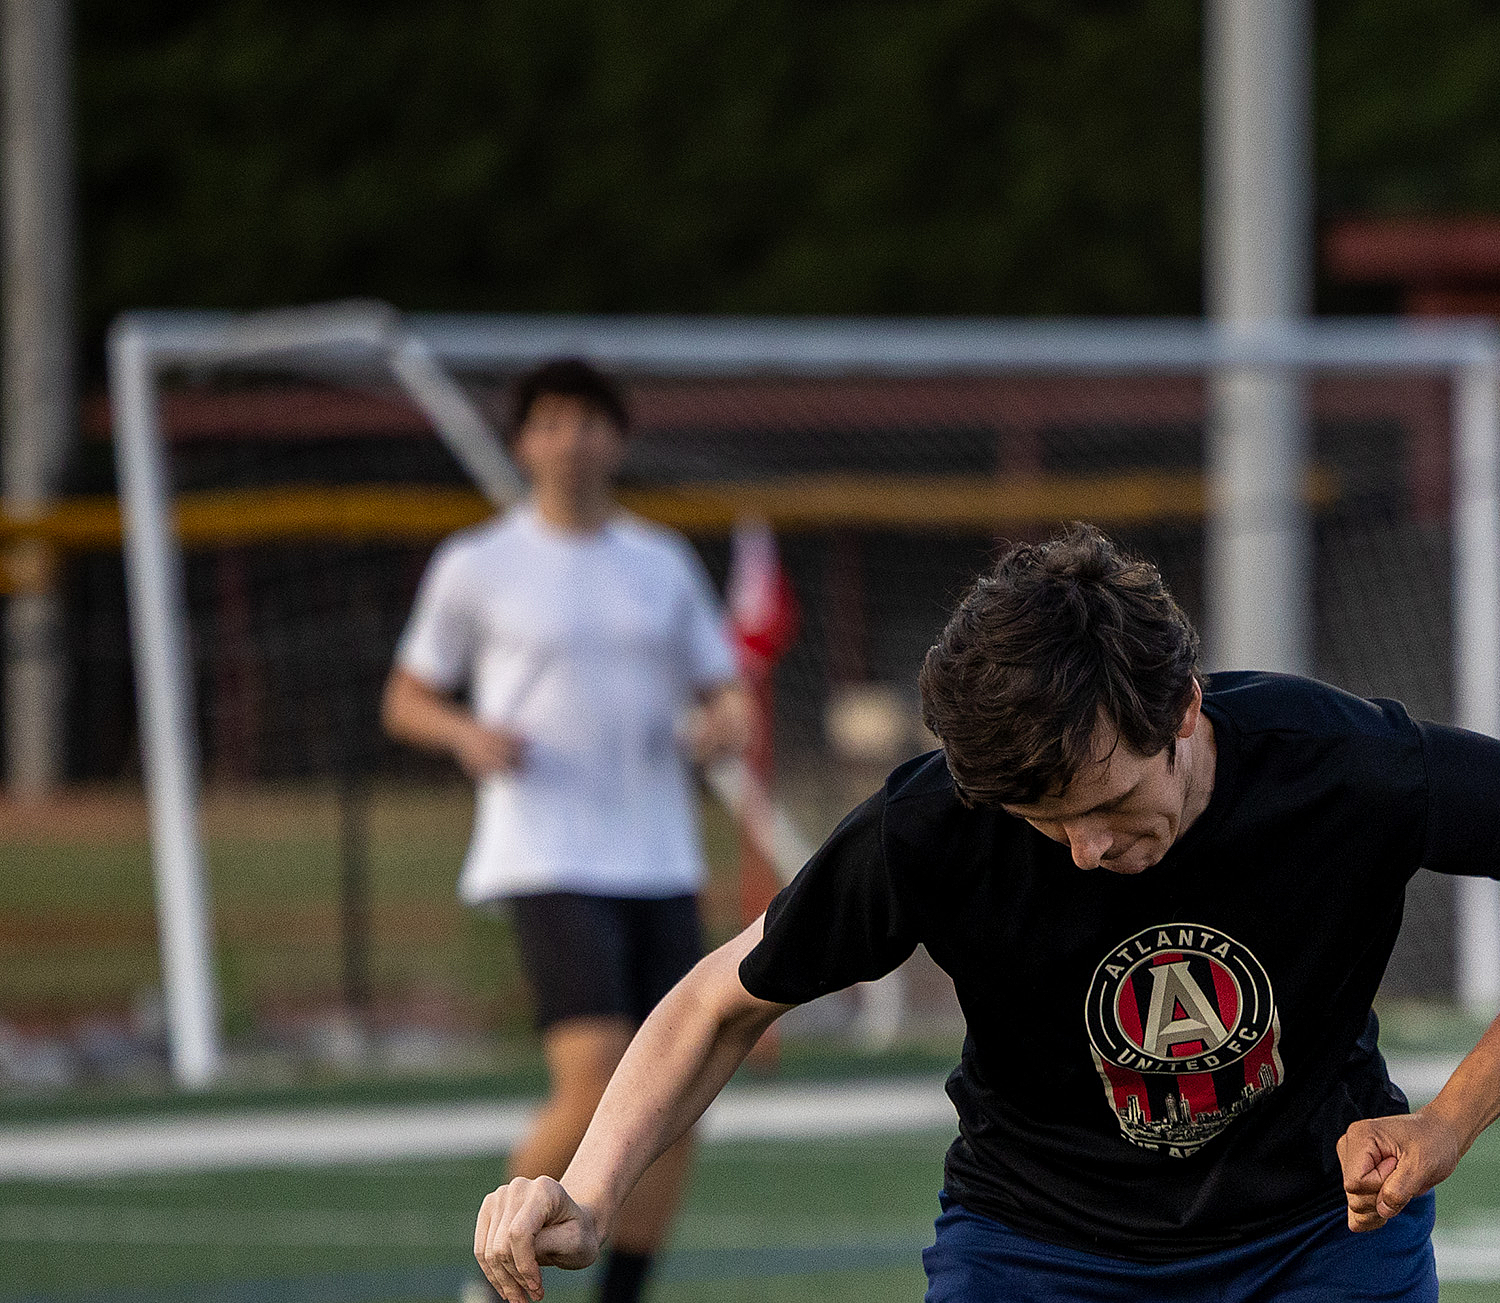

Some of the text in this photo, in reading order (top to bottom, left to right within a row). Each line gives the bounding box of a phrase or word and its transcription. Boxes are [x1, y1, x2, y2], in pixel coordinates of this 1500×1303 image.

[1104, 929, 1231, 980] ATLANTA
[1142, 960, 1230, 1058] A
[1116, 1026, 1260, 1073] UNITED FC
